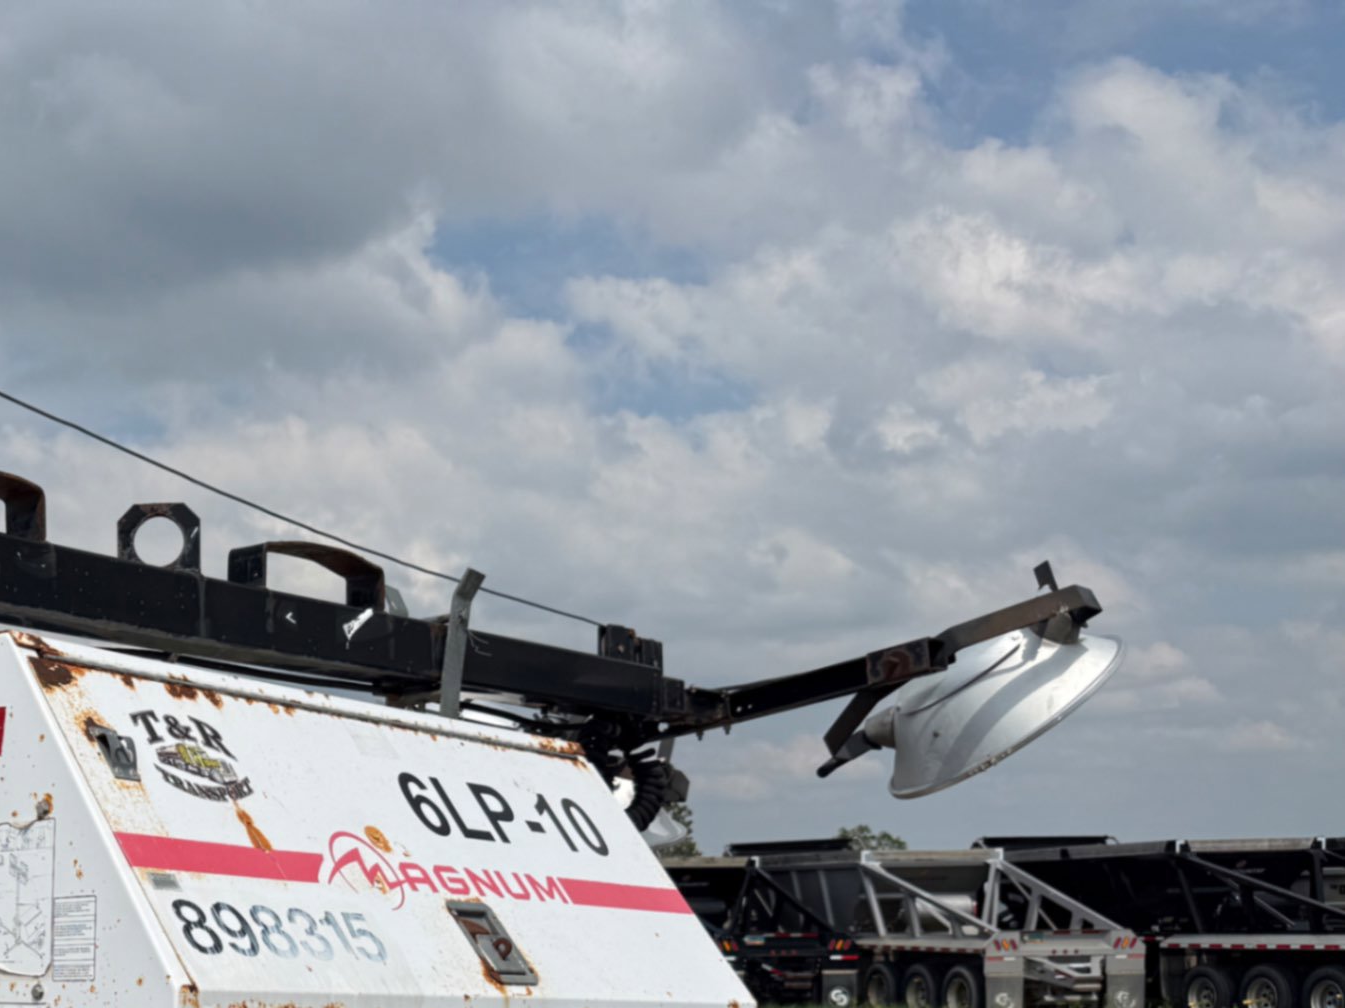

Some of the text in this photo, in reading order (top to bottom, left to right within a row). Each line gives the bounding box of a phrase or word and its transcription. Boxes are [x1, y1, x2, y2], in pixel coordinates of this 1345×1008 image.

[129, 710, 238, 762] T&R
[153, 762, 255, 802] TRANSPORT
[397, 771, 609, 857] 6LP-10
[328, 831, 569, 910] MAGNUM
[171, 898, 388, 963] 898315
